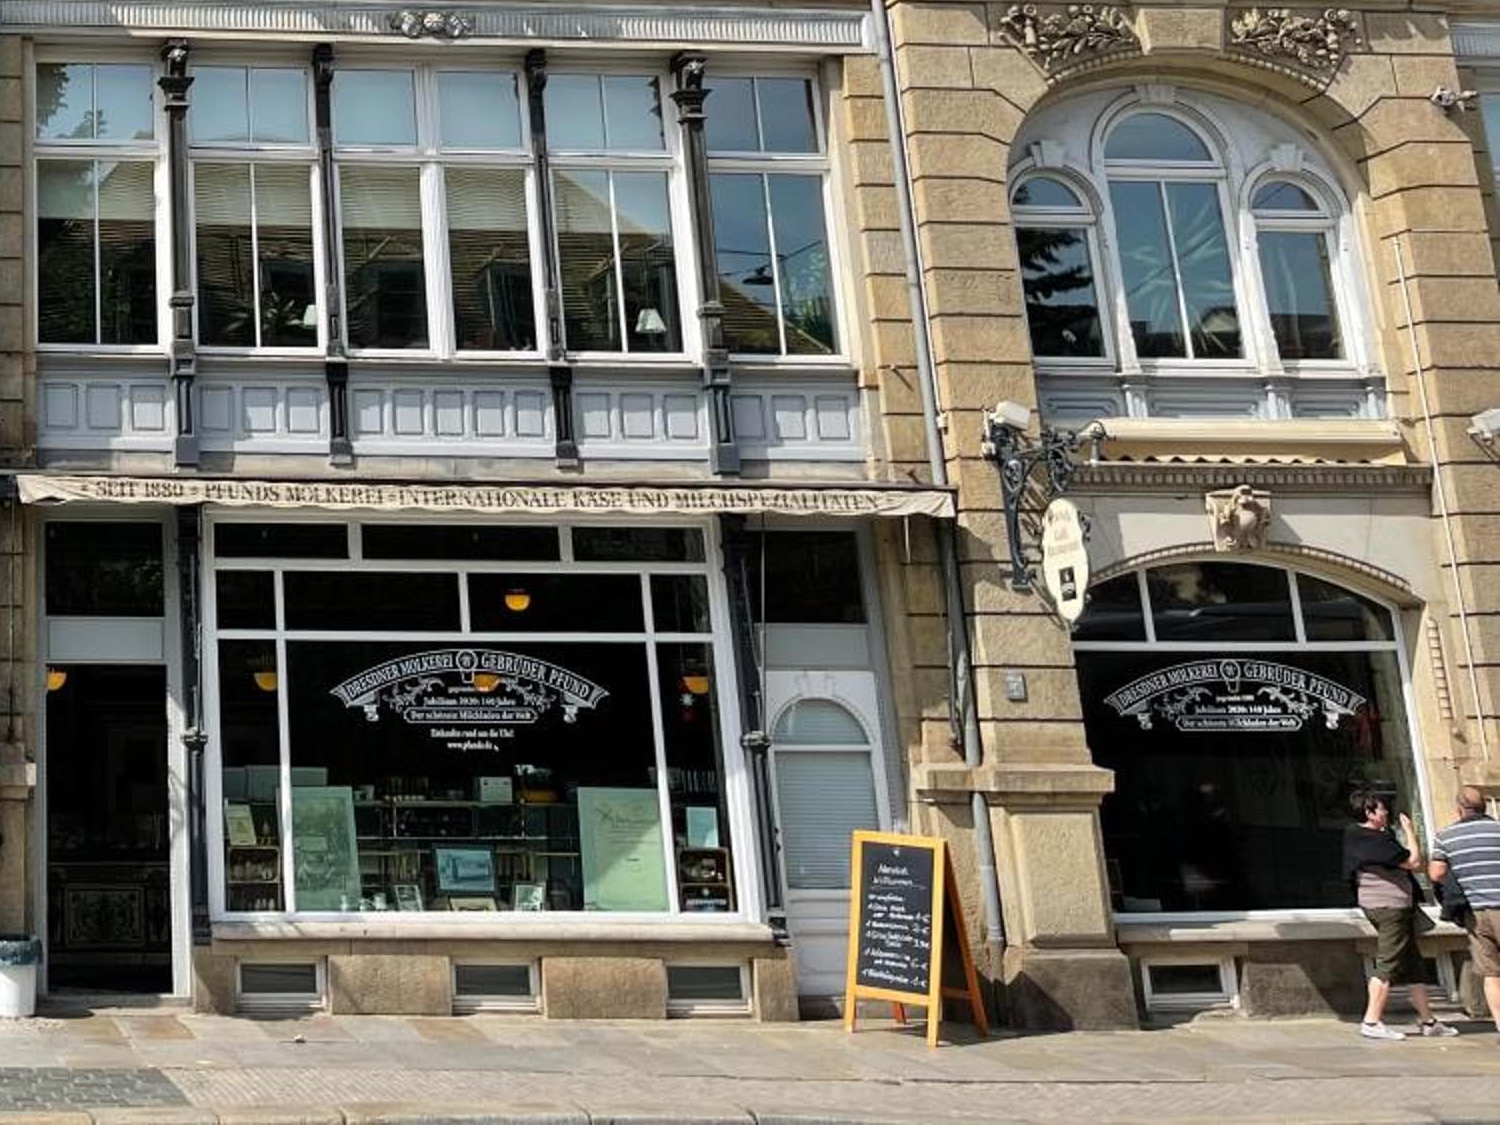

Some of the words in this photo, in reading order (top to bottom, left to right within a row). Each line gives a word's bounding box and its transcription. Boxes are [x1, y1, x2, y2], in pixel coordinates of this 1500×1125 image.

[95, 480, 137, 497] SEIT
[145, 482, 184, 498] 1880
[204, 484, 280, 502] PFUNDS
[285, 485, 383, 505] MOLKEREI
[399, 489, 567, 508] INTERNATIONALE
[347, 666, 402, 698] DRESDNER
[400, 653, 454, 676] MOLKEREI
[481, 653, 547, 683] GEBRÜDER
[548, 669, 590, 698] PFUND
